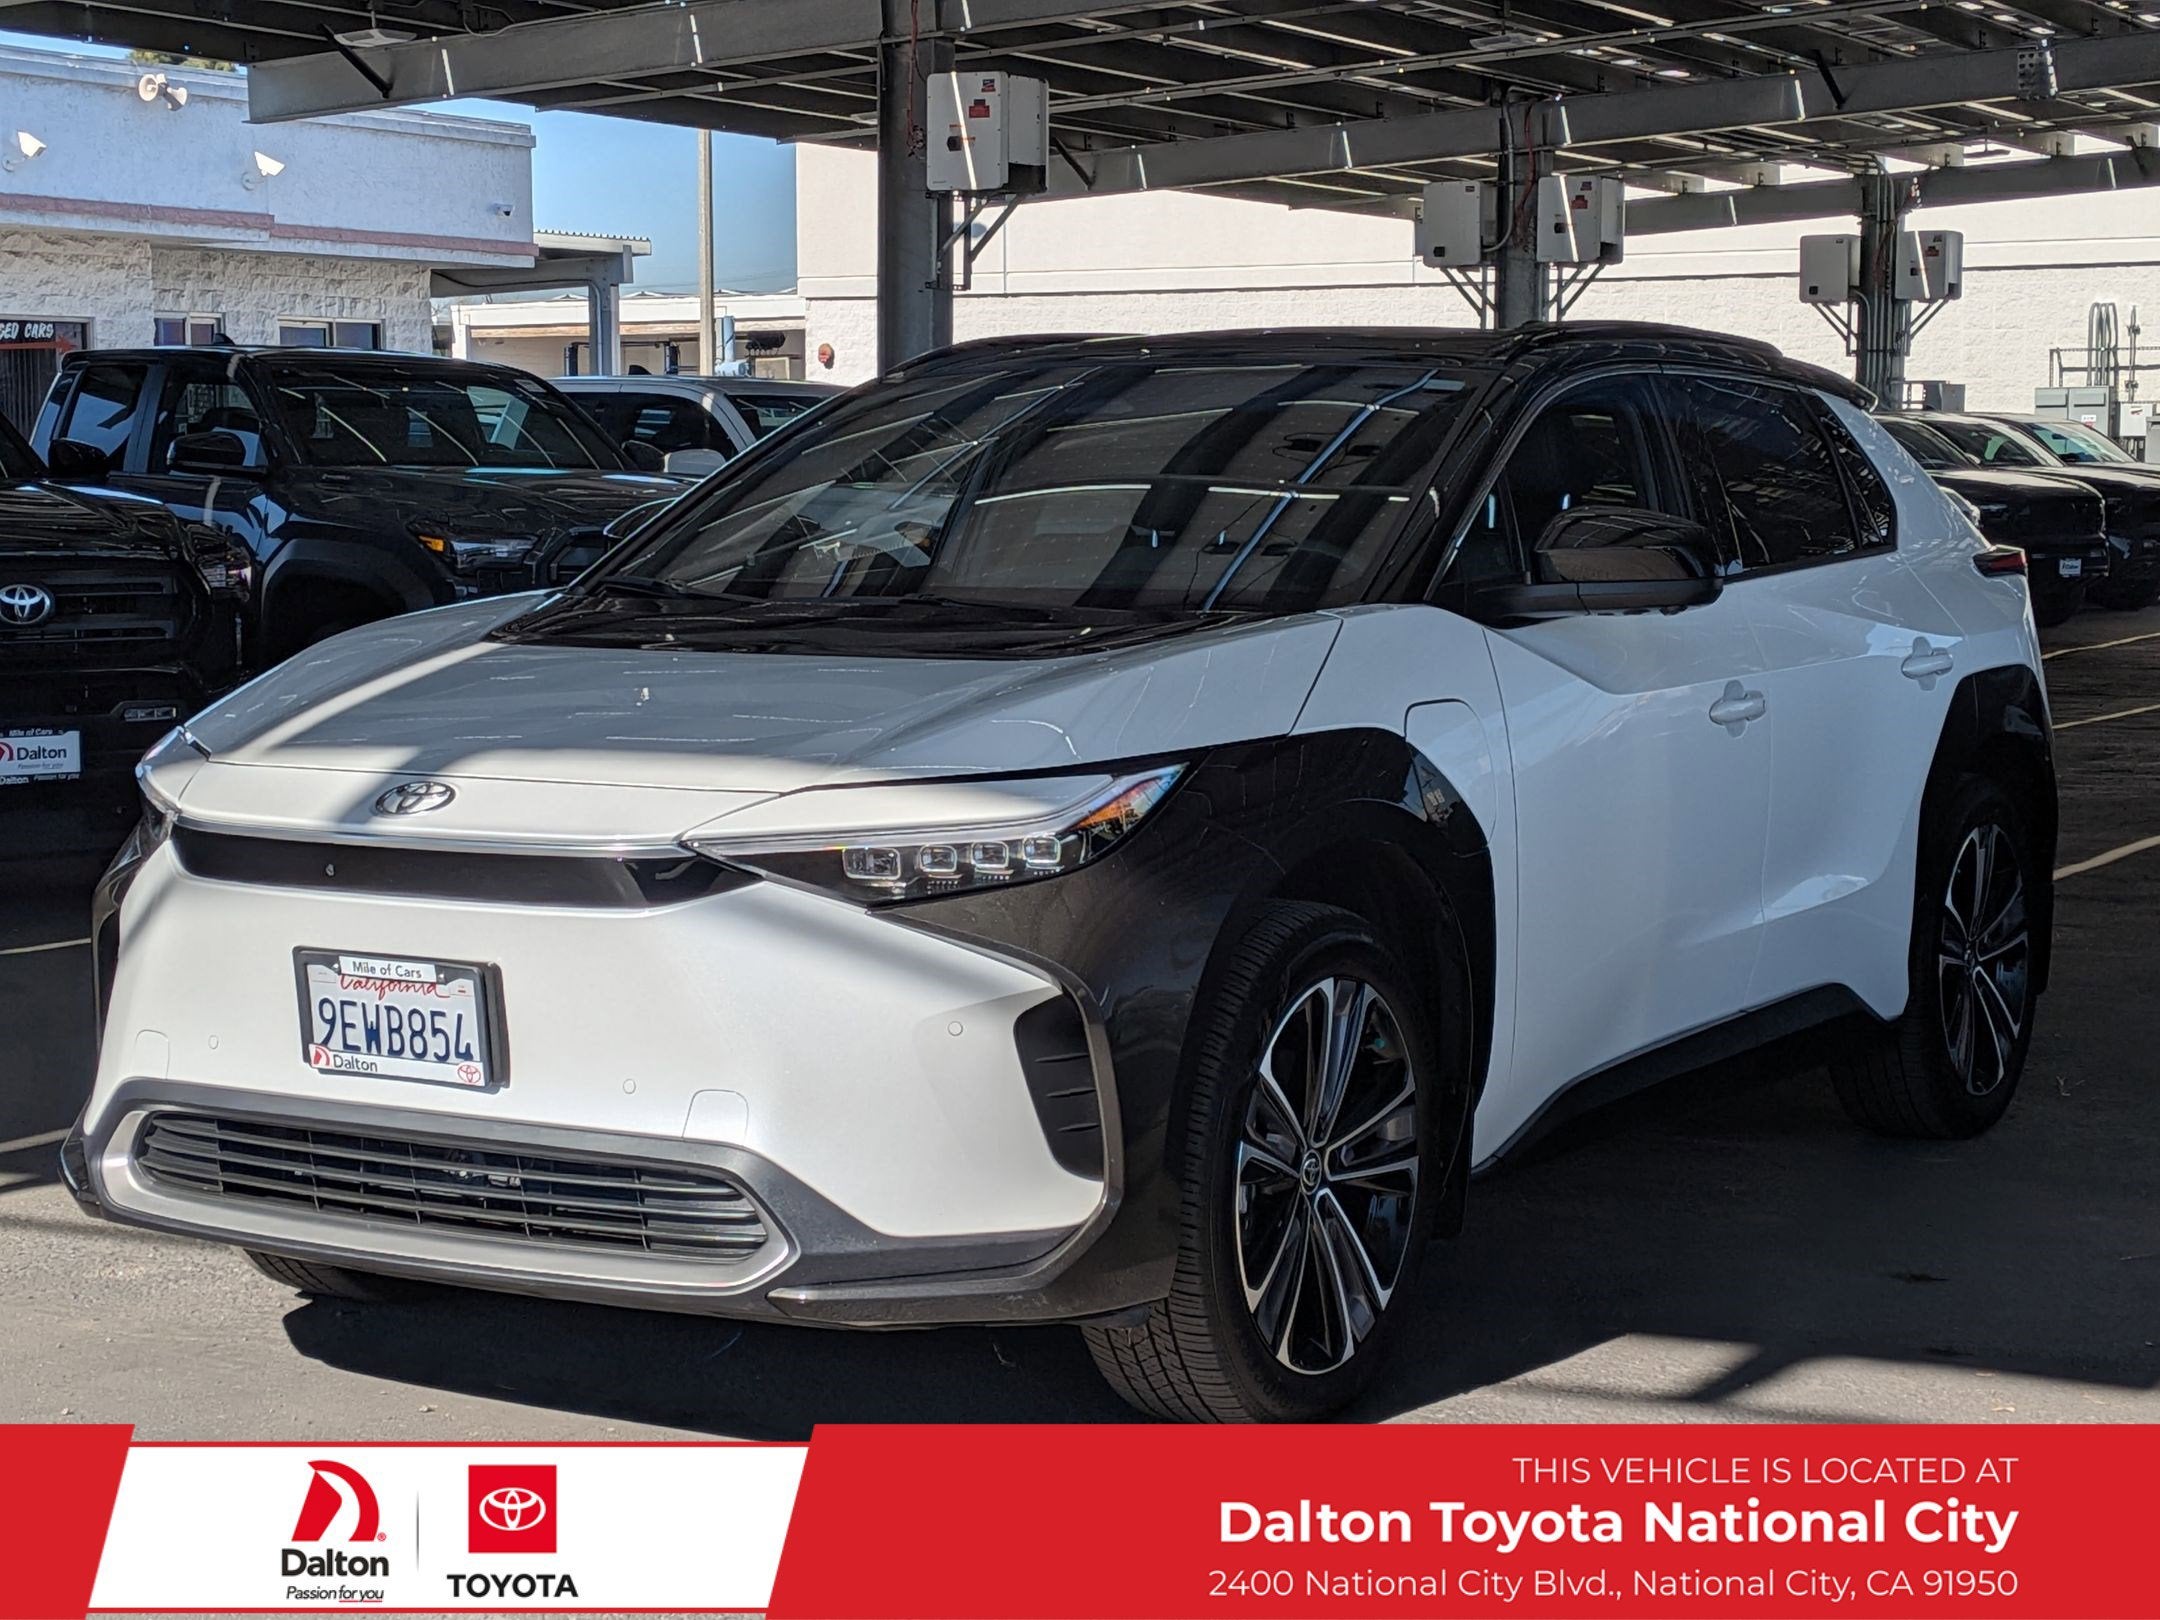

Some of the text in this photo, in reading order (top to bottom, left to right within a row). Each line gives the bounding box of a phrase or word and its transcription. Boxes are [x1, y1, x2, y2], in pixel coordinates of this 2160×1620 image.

[24, 322, 54, 339] CARS
[17, 746, 67, 761] Dalton
[352, 961, 422, 979] Mile of Cars
[318, 997, 474, 1063] 9EWB854
[333, 1054, 378, 1072] Dalton
